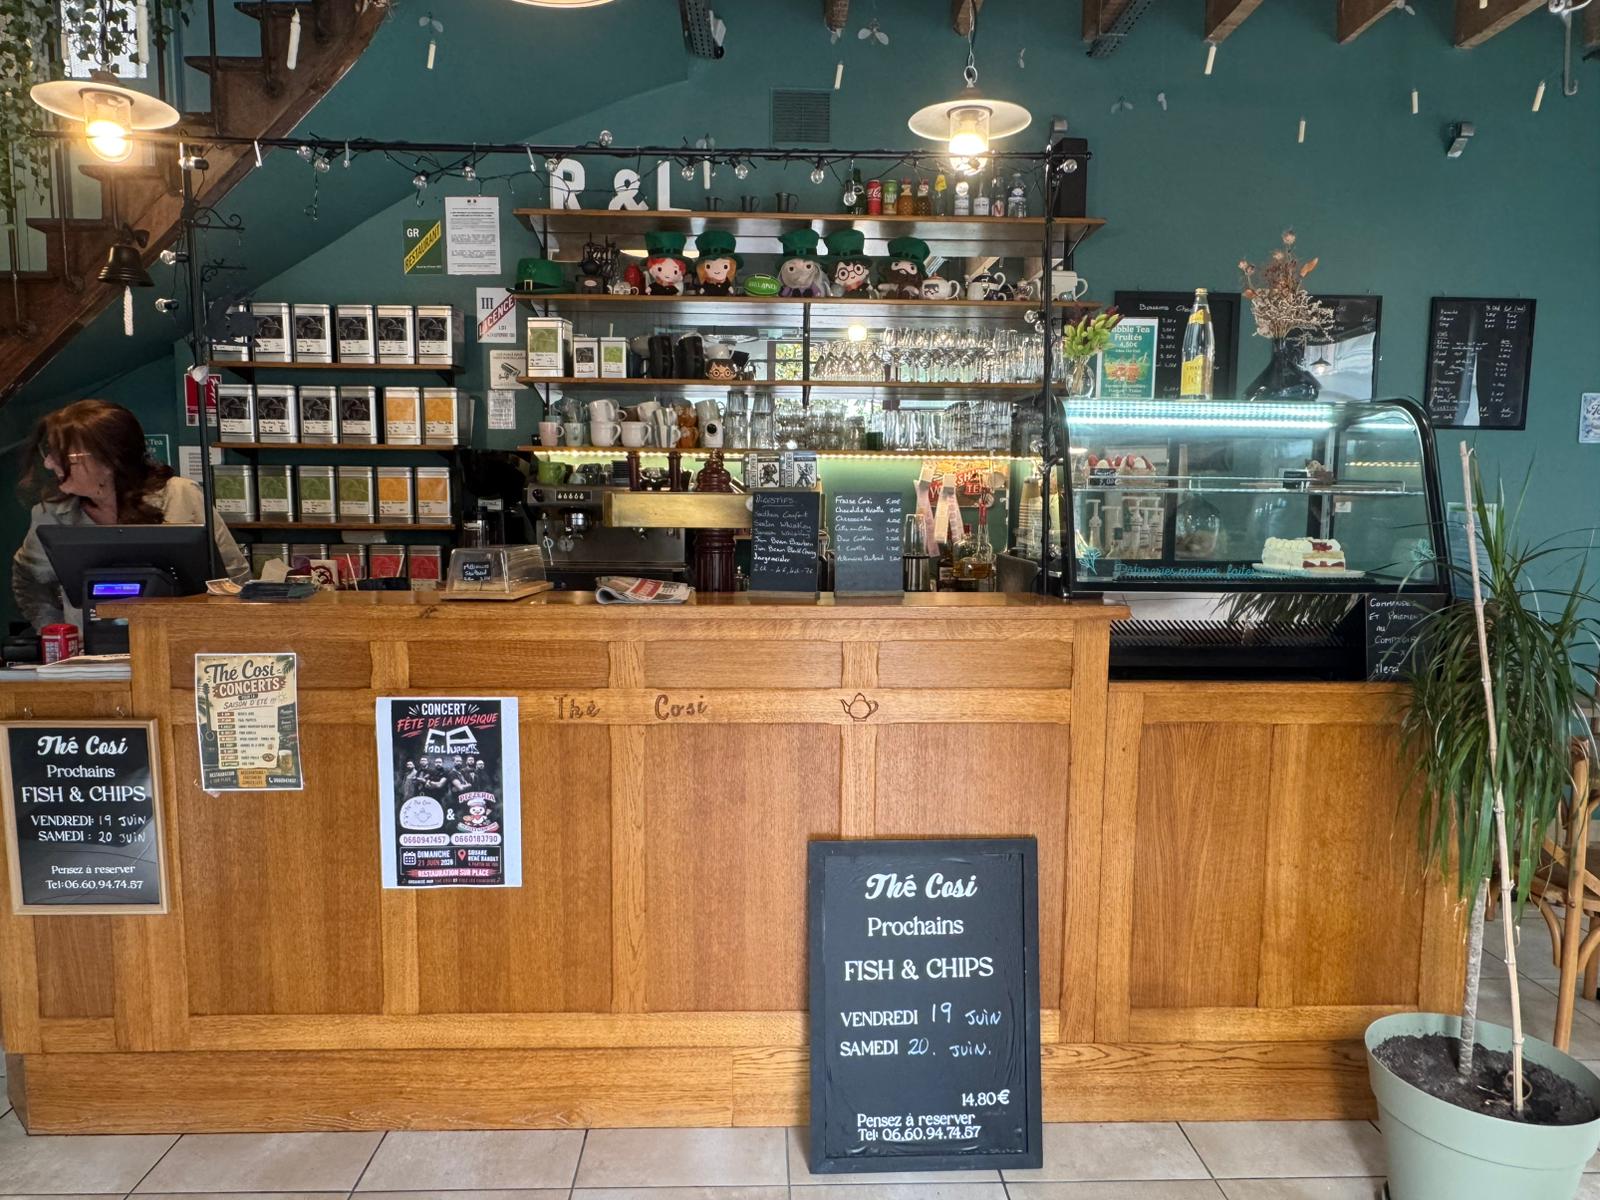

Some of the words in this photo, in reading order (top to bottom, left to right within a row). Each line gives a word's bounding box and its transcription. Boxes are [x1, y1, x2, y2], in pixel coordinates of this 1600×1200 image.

[549, 158, 586, 211] R
[608, 168, 650, 211] &
[406, 228, 420, 238] GR
[404, 222, 441, 271] RESTAURANT
[481, 297, 494, 310] III
[480, 295, 514, 337] LICENCE
[241, 659, 275, 680] Cosi
[219, 677, 281, 697] CONCERTS
[223, 698, 248, 710] SAISON
[421, 703, 467, 716] CONCERT
[654, 693, 708, 721] Cosi
[396, 715, 425, 732] FÊTE
[427, 718, 440, 729] DE
[441, 716, 454, 727] LA
[454, 712, 500, 726] MUSIQUE
[37, 736, 79, 755] Thé
[85, 735, 129, 755] Cosi
[47, 765, 116, 778] Prochains
[21, 786, 63, 803] FISH
[69, 786, 85, 803] &
[89, 786, 147, 802] CHIPS
[99, 815, 112, 827] 19
[446, 808, 455, 821] &
[38, 830, 85, 842] SAMEDI
[98, 831, 113, 843] 20
[417, 850, 451, 858] DIMANCHE
[51, 865, 83, 875] Pensez
[94, 865, 136, 875] reserver
[417, 868, 459, 878] RESTAURATION
[472, 868, 489, 876] PLACE
[865, 873, 918, 900] Thé
[925, 872, 979, 900] Cosi
[867, 916, 964, 937] Prochains
[844, 960, 894, 981] FISH
[901, 959, 919, 981] &
[926, 956, 994, 979] CHIPS
[840, 1009, 919, 1027] VENDREDI
[932, 1002, 952, 1024] 19
[839, 1039, 899, 1057] SAMEDI
[857, 1113, 902, 1128] Pensez
[918, 1113, 976, 1126] reserver
